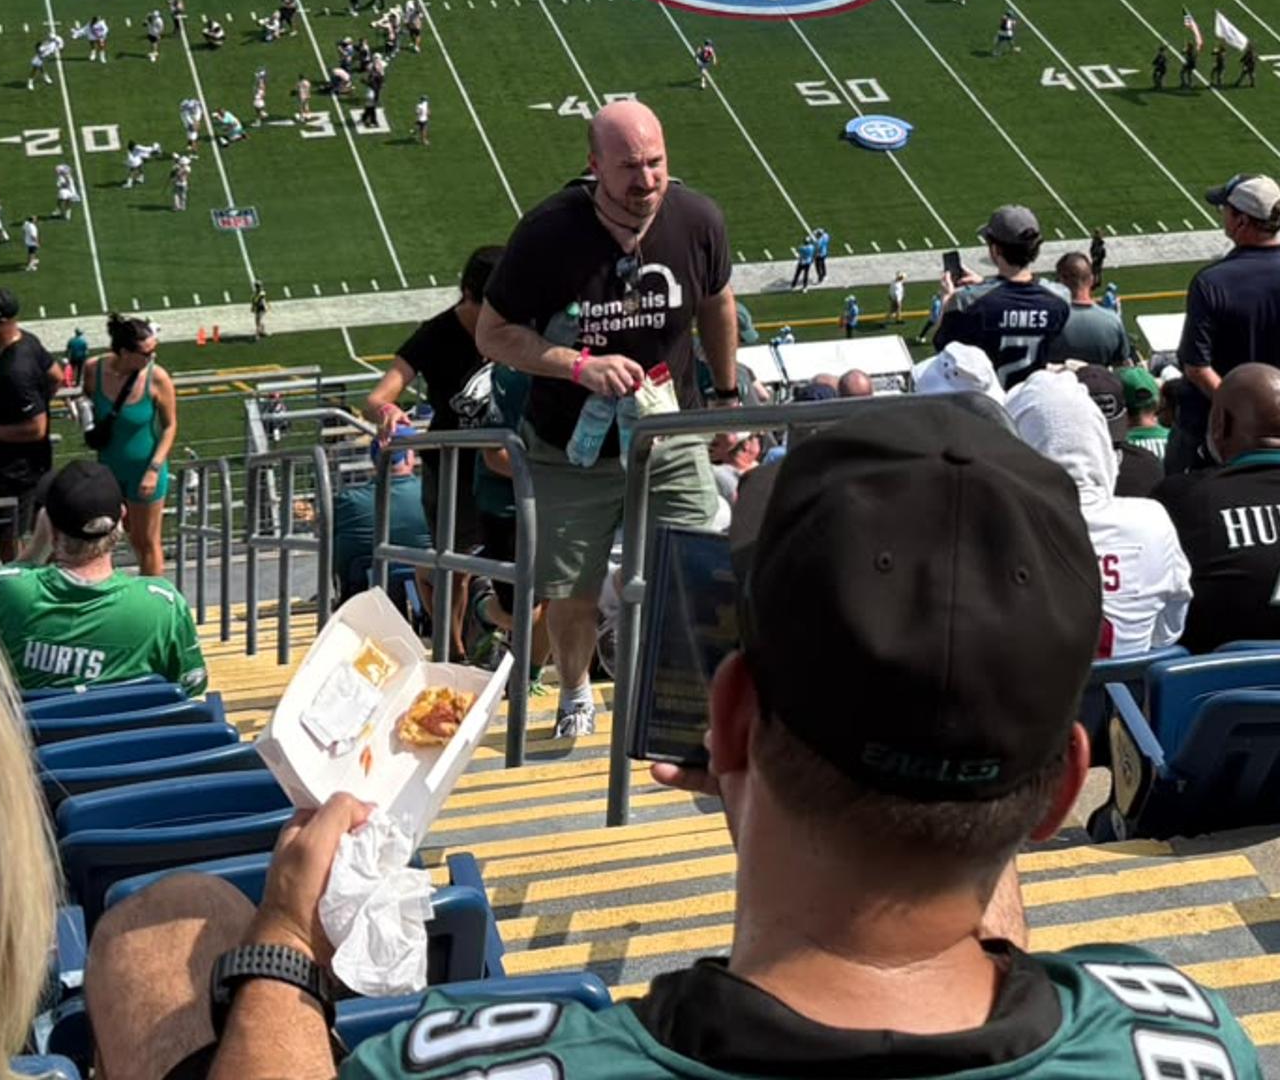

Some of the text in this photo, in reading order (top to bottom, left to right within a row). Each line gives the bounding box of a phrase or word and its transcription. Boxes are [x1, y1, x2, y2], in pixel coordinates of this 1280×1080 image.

[1041, 64, 1126, 92] 40
[795, 78, 889, 107] 50
[23, 125, 120, 156] 20
[580, 292, 666, 318] Memis
[999, 310, 1049, 328] JONES
[577, 332, 608, 347] ab
[23, 639, 106, 679] HURTS
